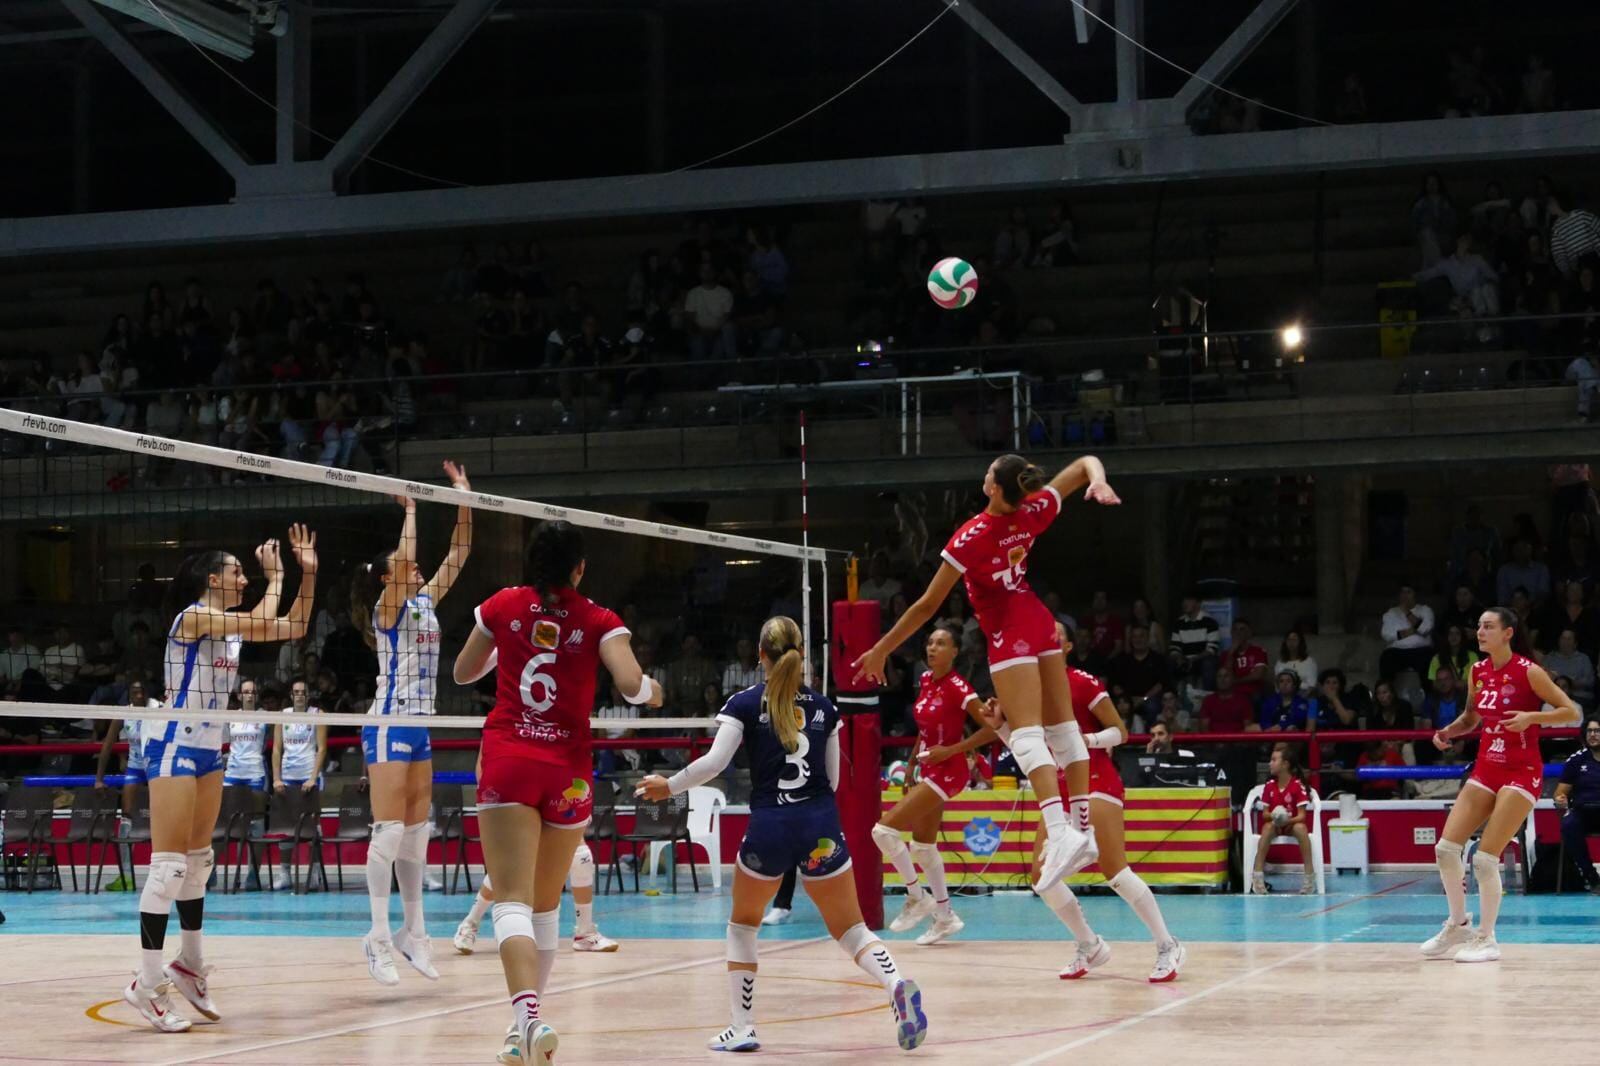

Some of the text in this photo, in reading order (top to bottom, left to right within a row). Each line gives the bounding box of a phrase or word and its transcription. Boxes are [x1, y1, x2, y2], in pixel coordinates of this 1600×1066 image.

[22, 415, 67, 434] rfevb.com
[136, 436, 176, 453] rfevb.com
[236, 453, 272, 469] rfevb.com
[325, 469, 357, 483] rfevb.com
[405, 482, 434, 496] rfevb.com
[999, 532, 1032, 547] FORTUNA
[1236, 656, 1247, 669] 13
[519, 652, 558, 713] 6
[915, 698, 928, 714] 4
[1478, 689, 1498, 709] 22
[777, 731, 811, 790] 3
